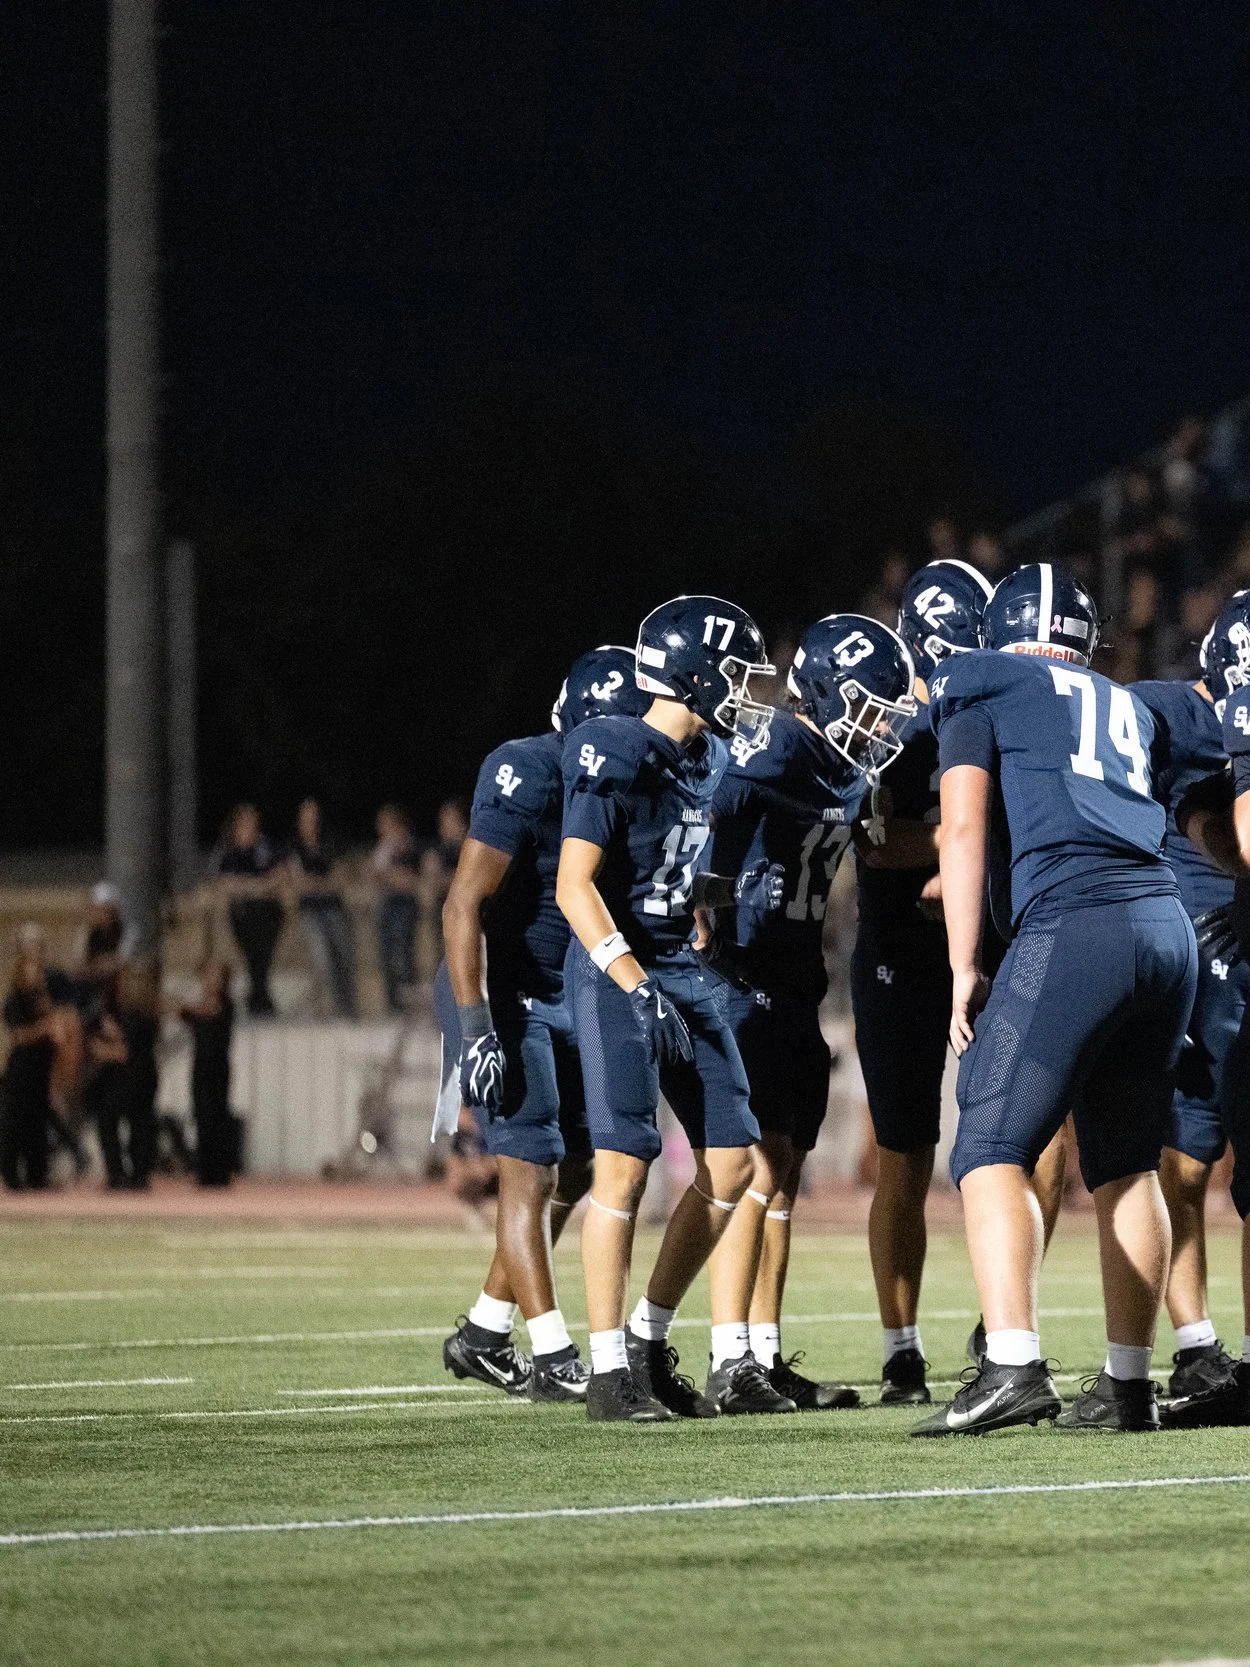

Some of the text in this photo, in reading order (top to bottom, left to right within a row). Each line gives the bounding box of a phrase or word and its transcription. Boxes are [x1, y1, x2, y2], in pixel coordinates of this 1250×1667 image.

[913, 585, 955, 630] 42
[702, 615, 736, 651] 17
[832, 631, 875, 667] 13
[590, 670, 624, 702] 3
[1048, 665, 1149, 797] 74
[579, 743, 606, 777] SV
[495, 763, 522, 797] SV
[643, 824, 710, 917] 17
[1211, 958, 1229, 980] SV
[997, 1390, 1015, 1407] ALPHA
